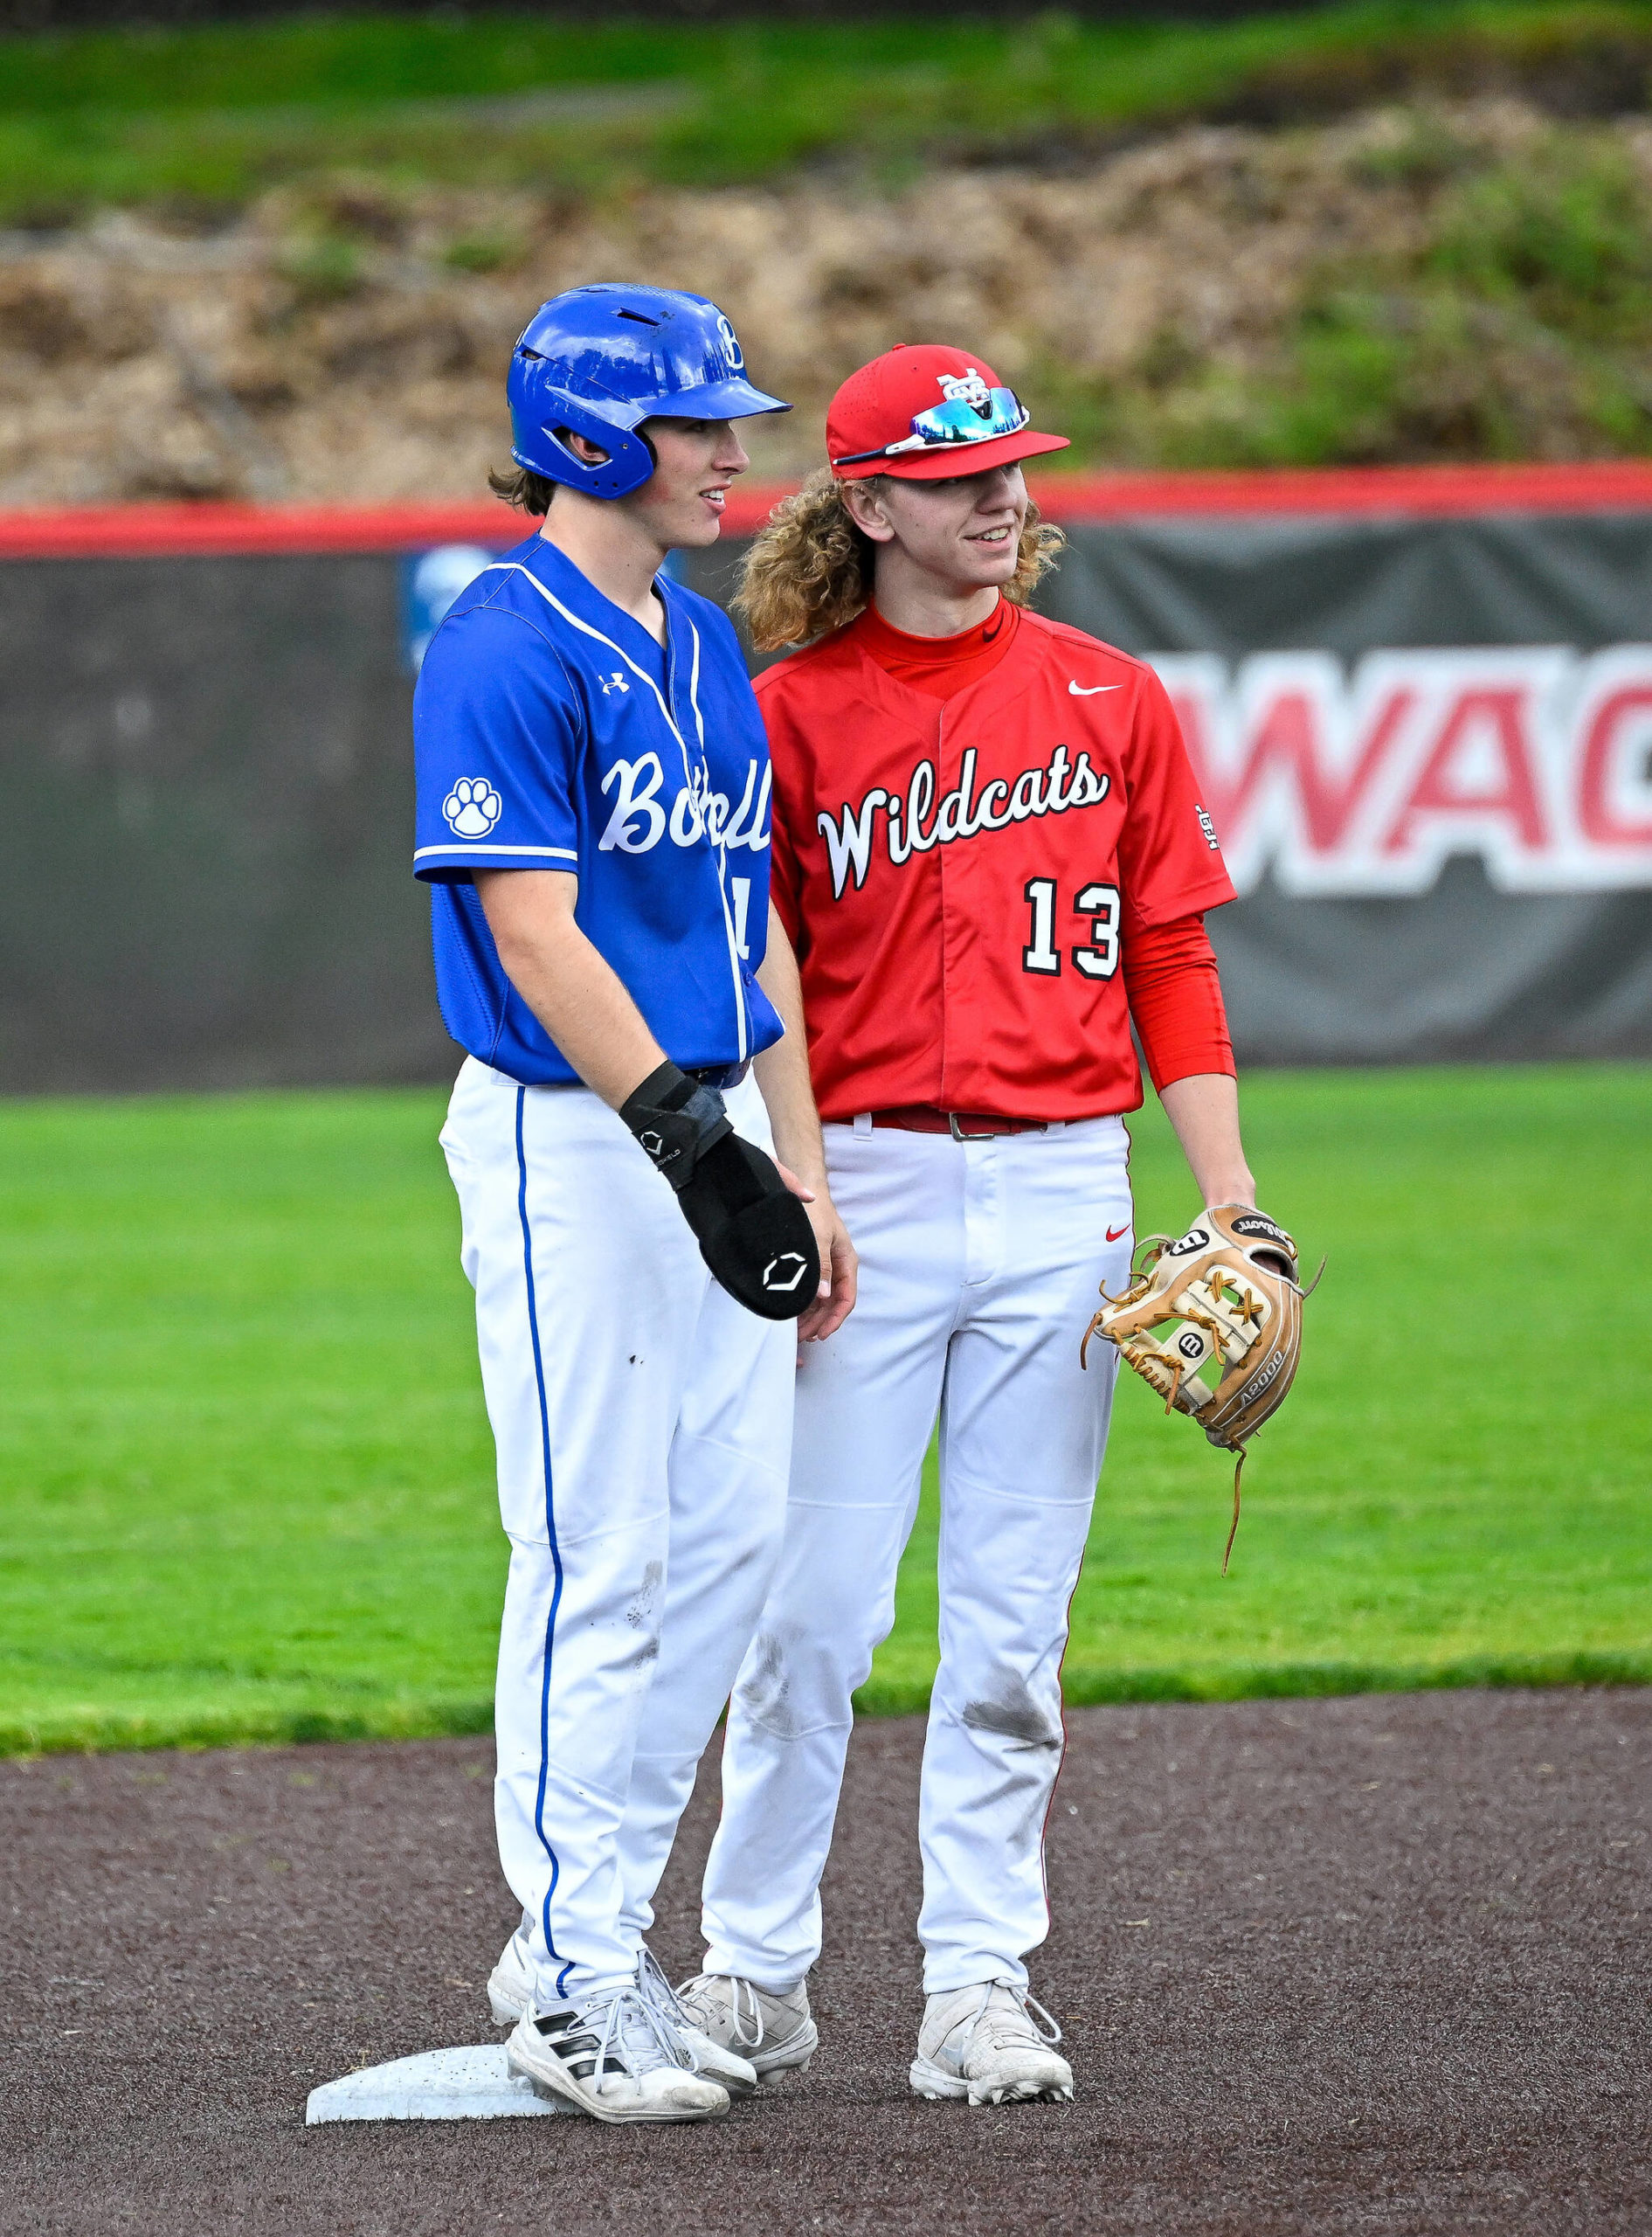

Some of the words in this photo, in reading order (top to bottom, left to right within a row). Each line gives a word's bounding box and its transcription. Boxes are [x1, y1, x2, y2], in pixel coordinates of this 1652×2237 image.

[716, 314, 744, 370] B
[818, 745, 1109, 900] Wildcats
[1022, 876, 1121, 980] 13
